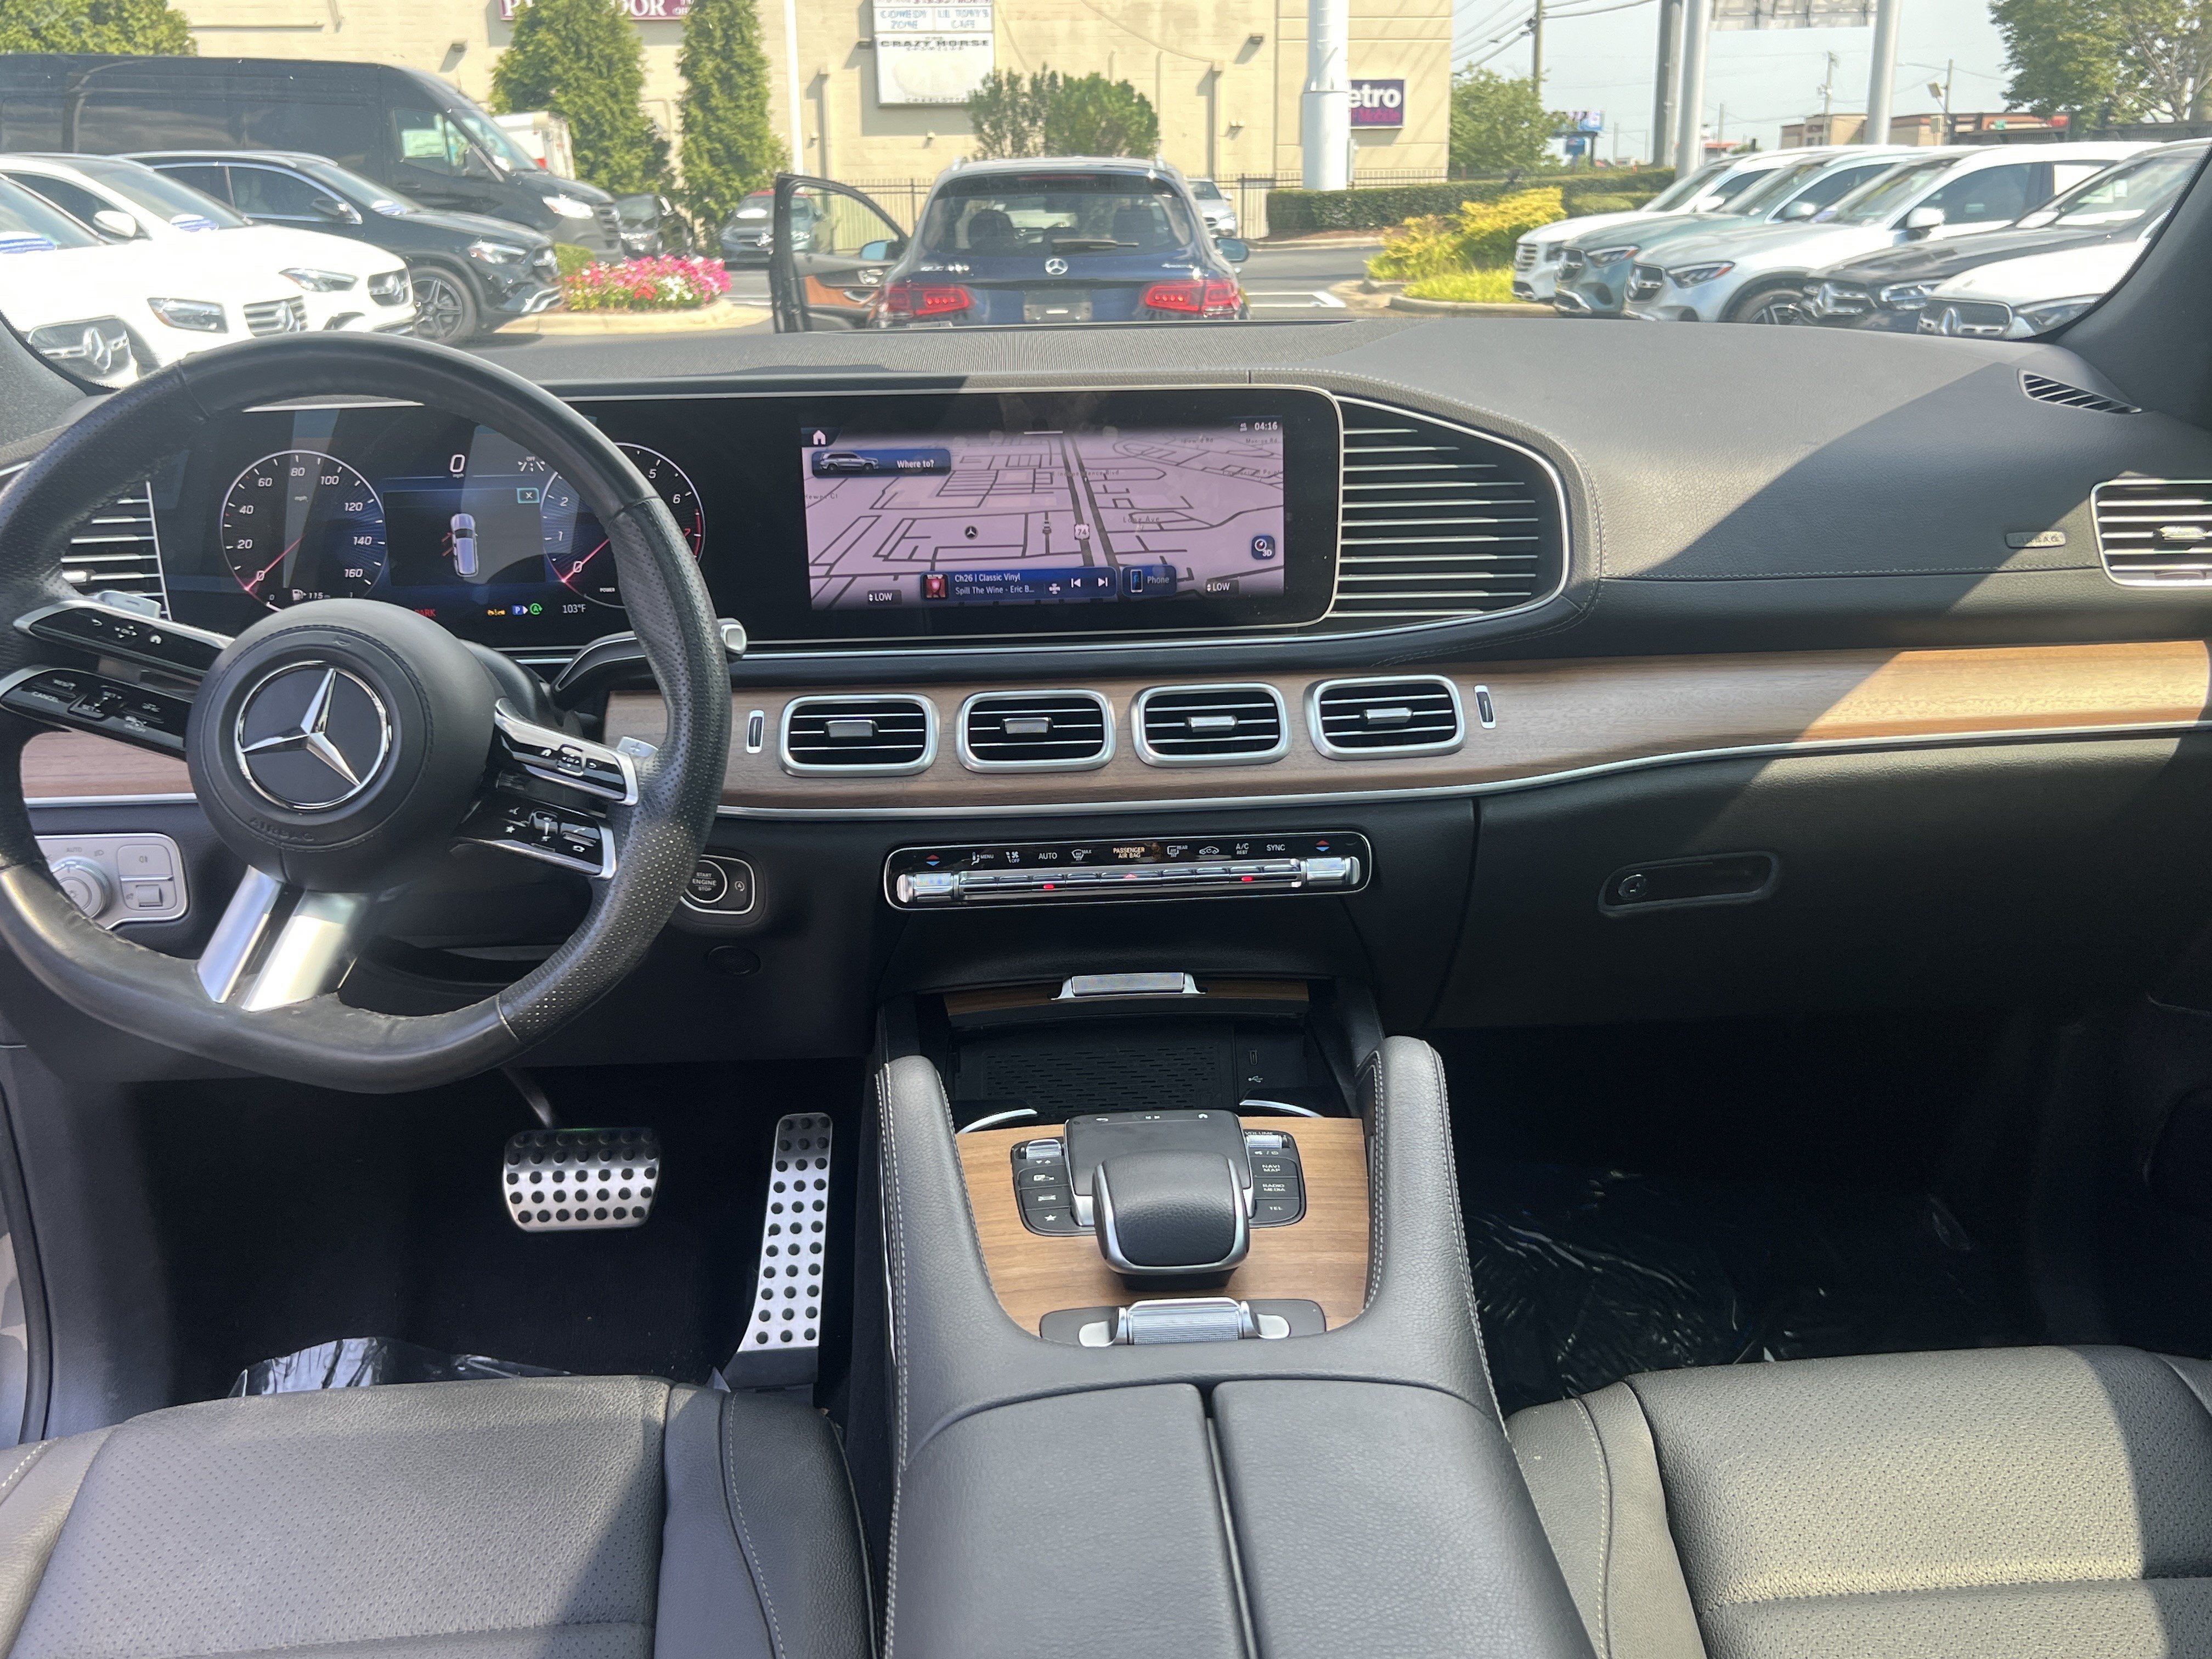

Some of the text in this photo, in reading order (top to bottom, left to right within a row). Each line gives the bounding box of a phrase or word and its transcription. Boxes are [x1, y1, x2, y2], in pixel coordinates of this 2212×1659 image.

[1349, 83, 1402, 108] etro
[1254, 421, 1278, 431] 04:16
[450, 454, 466, 473] 0
[897, 459, 935, 469] Where to?
[291, 467, 306, 477] 80
[648, 469, 657, 479] 5
[258, 478, 273, 487] 60
[320, 476, 340, 485] 100
[560, 496, 568, 506] 2
[673, 494, 681, 504] 6
[239, 505, 254, 515] 40
[345, 502, 363, 511] 120
[353, 536, 373, 545] 140
[558, 531, 563, 541] 1
[236, 539, 253, 549] 20
[573, 561, 583, 573] 0
[256, 570, 265, 582] 0
[344, 568, 363, 578] 160
[979, 573, 1002, 582] Classic
[1003, 573, 1021, 582] Vinyl
[1147, 576, 1170, 584] Phone
[955, 586, 970, 595] Spill
[972, 586, 985, 594] The
[1010, 585, 1023, 593] Eric
[1212, 583, 1231, 591] LOW
[874, 592, 893, 601] LOW
[562, 604, 586, 613] 103°F
